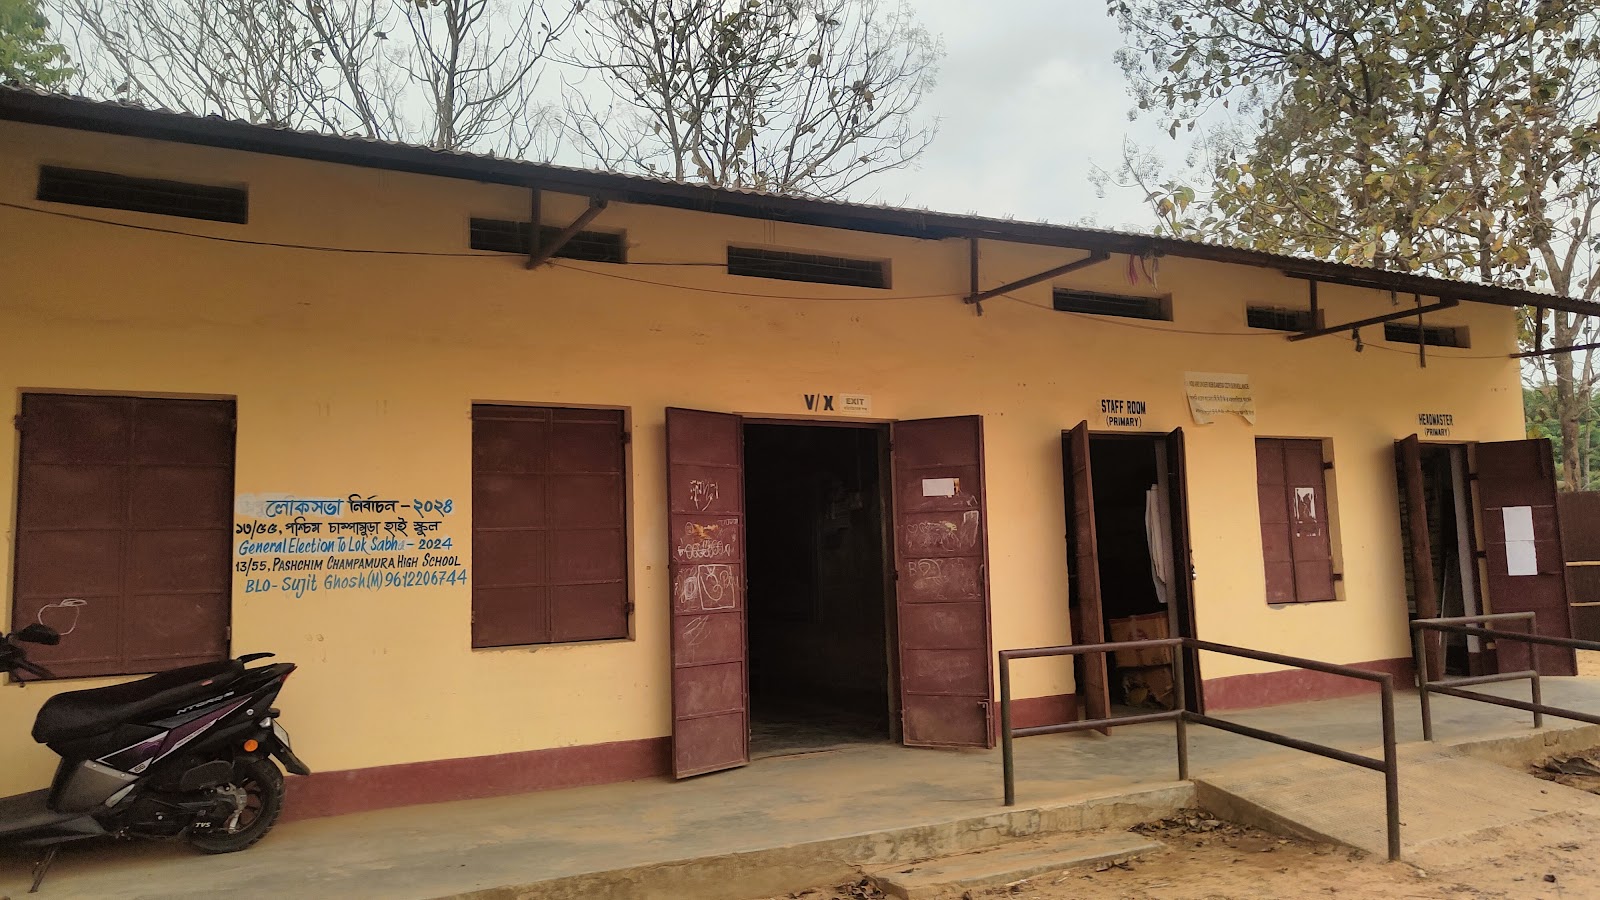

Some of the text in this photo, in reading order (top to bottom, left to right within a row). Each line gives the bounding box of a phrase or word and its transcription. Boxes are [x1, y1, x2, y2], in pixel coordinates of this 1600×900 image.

[846, 397, 864, 405] EXIT
[1101, 399, 1146, 415] STAFF ROOM
[1106, 415, 1142, 428] (PRIMARY)
[1418, 413, 1454, 426] HEADMASTER
[1424, 427, 1450, 437] (PRIMARY)
[266, 499, 344, 517] লোকসভা
[347, 494, 399, 513] নির্বাচন
[413, 499, 453, 518] ২০২৪
[285, 516, 323, 536] পশ্চিম
[328, 521, 381, 538] চাম্পামুড়া
[384, 517, 408, 537] হাই
[413, 521, 442, 537] স্কুল
[239, 538, 287, 555] General
[288, 537, 335, 554] Election
[337, 536, 346, 553] To
[348, 536, 371, 555] Lok
[371, 535, 405, 551] Sabha
[418, 537, 453, 550] 2024
[236, 558, 271, 576] 13/55,
[272, 557, 323, 571] PASHCHIM
[326, 555, 395, 570] CHAMPAMURA
[422, 552, 461, 567] SCHOOL
[281, 574, 317, 599] Sujit
[324, 572, 365, 590] Ghosh
[385, 569, 467, 588] 9612206744
